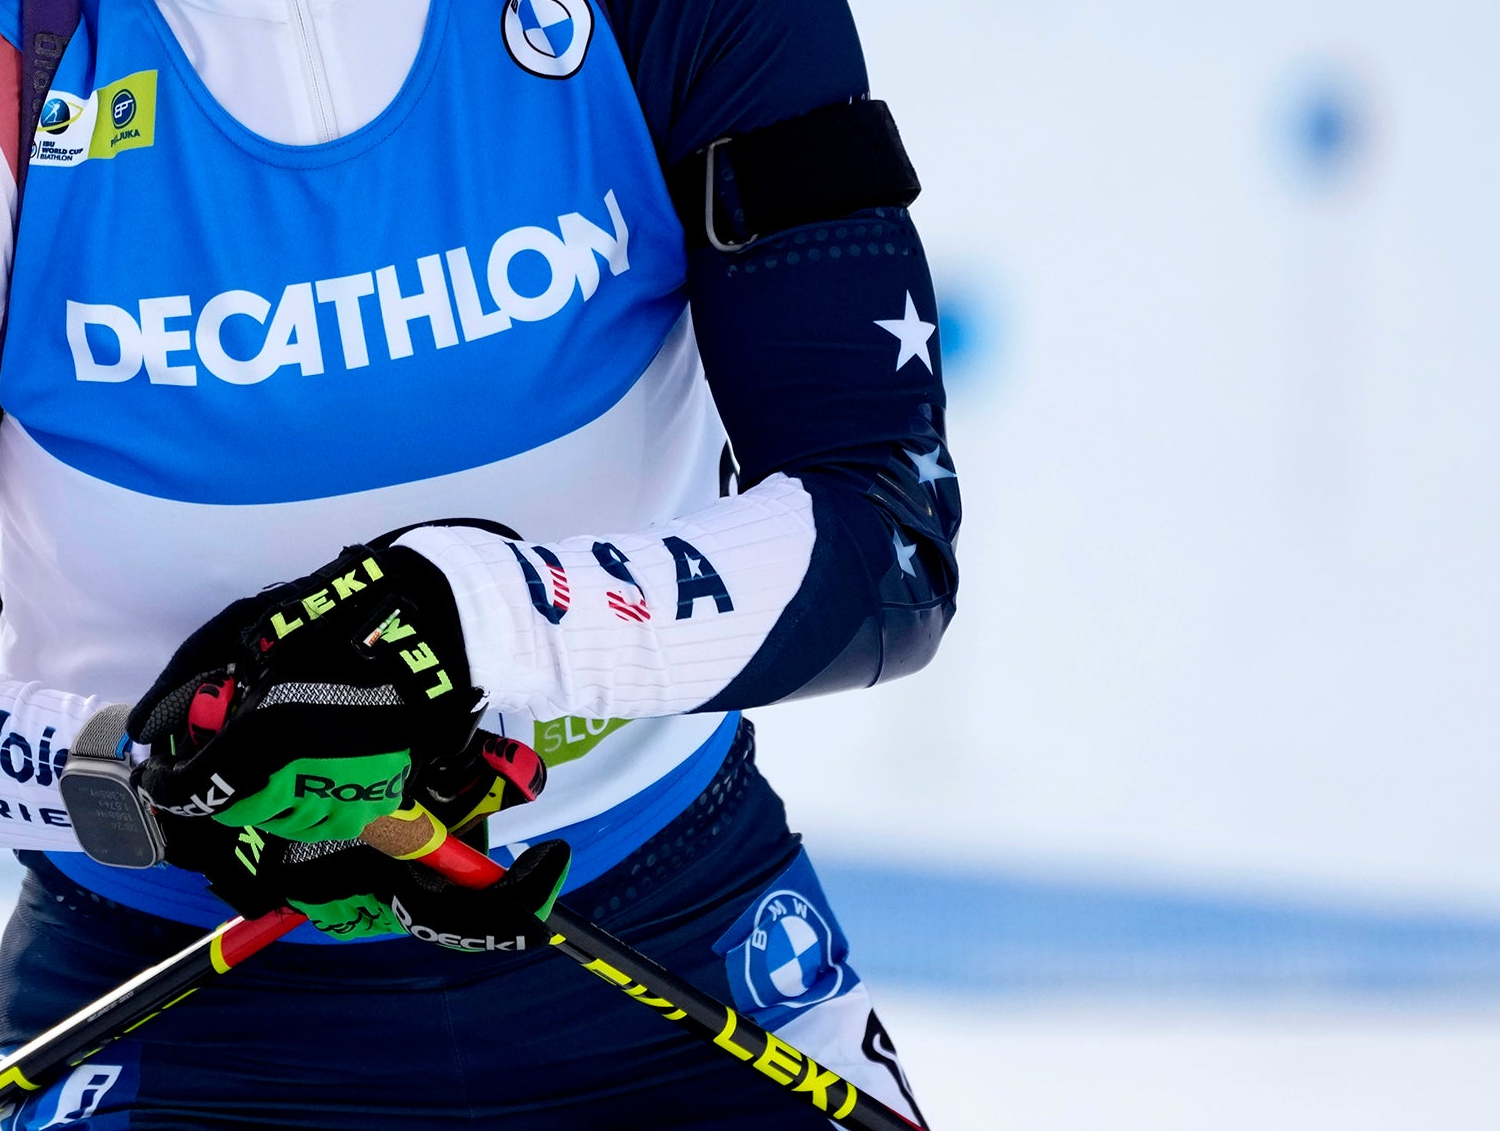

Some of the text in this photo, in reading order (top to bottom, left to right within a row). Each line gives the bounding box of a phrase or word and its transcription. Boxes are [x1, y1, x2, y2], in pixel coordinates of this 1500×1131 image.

[41, 147, 68, 155] WORLD
[66, 188, 631, 387] DECATHLON
[270, 556, 385, 640] LEKI
[502, 535, 735, 626] USA
[713, 1006, 859, 1120] LEKI
